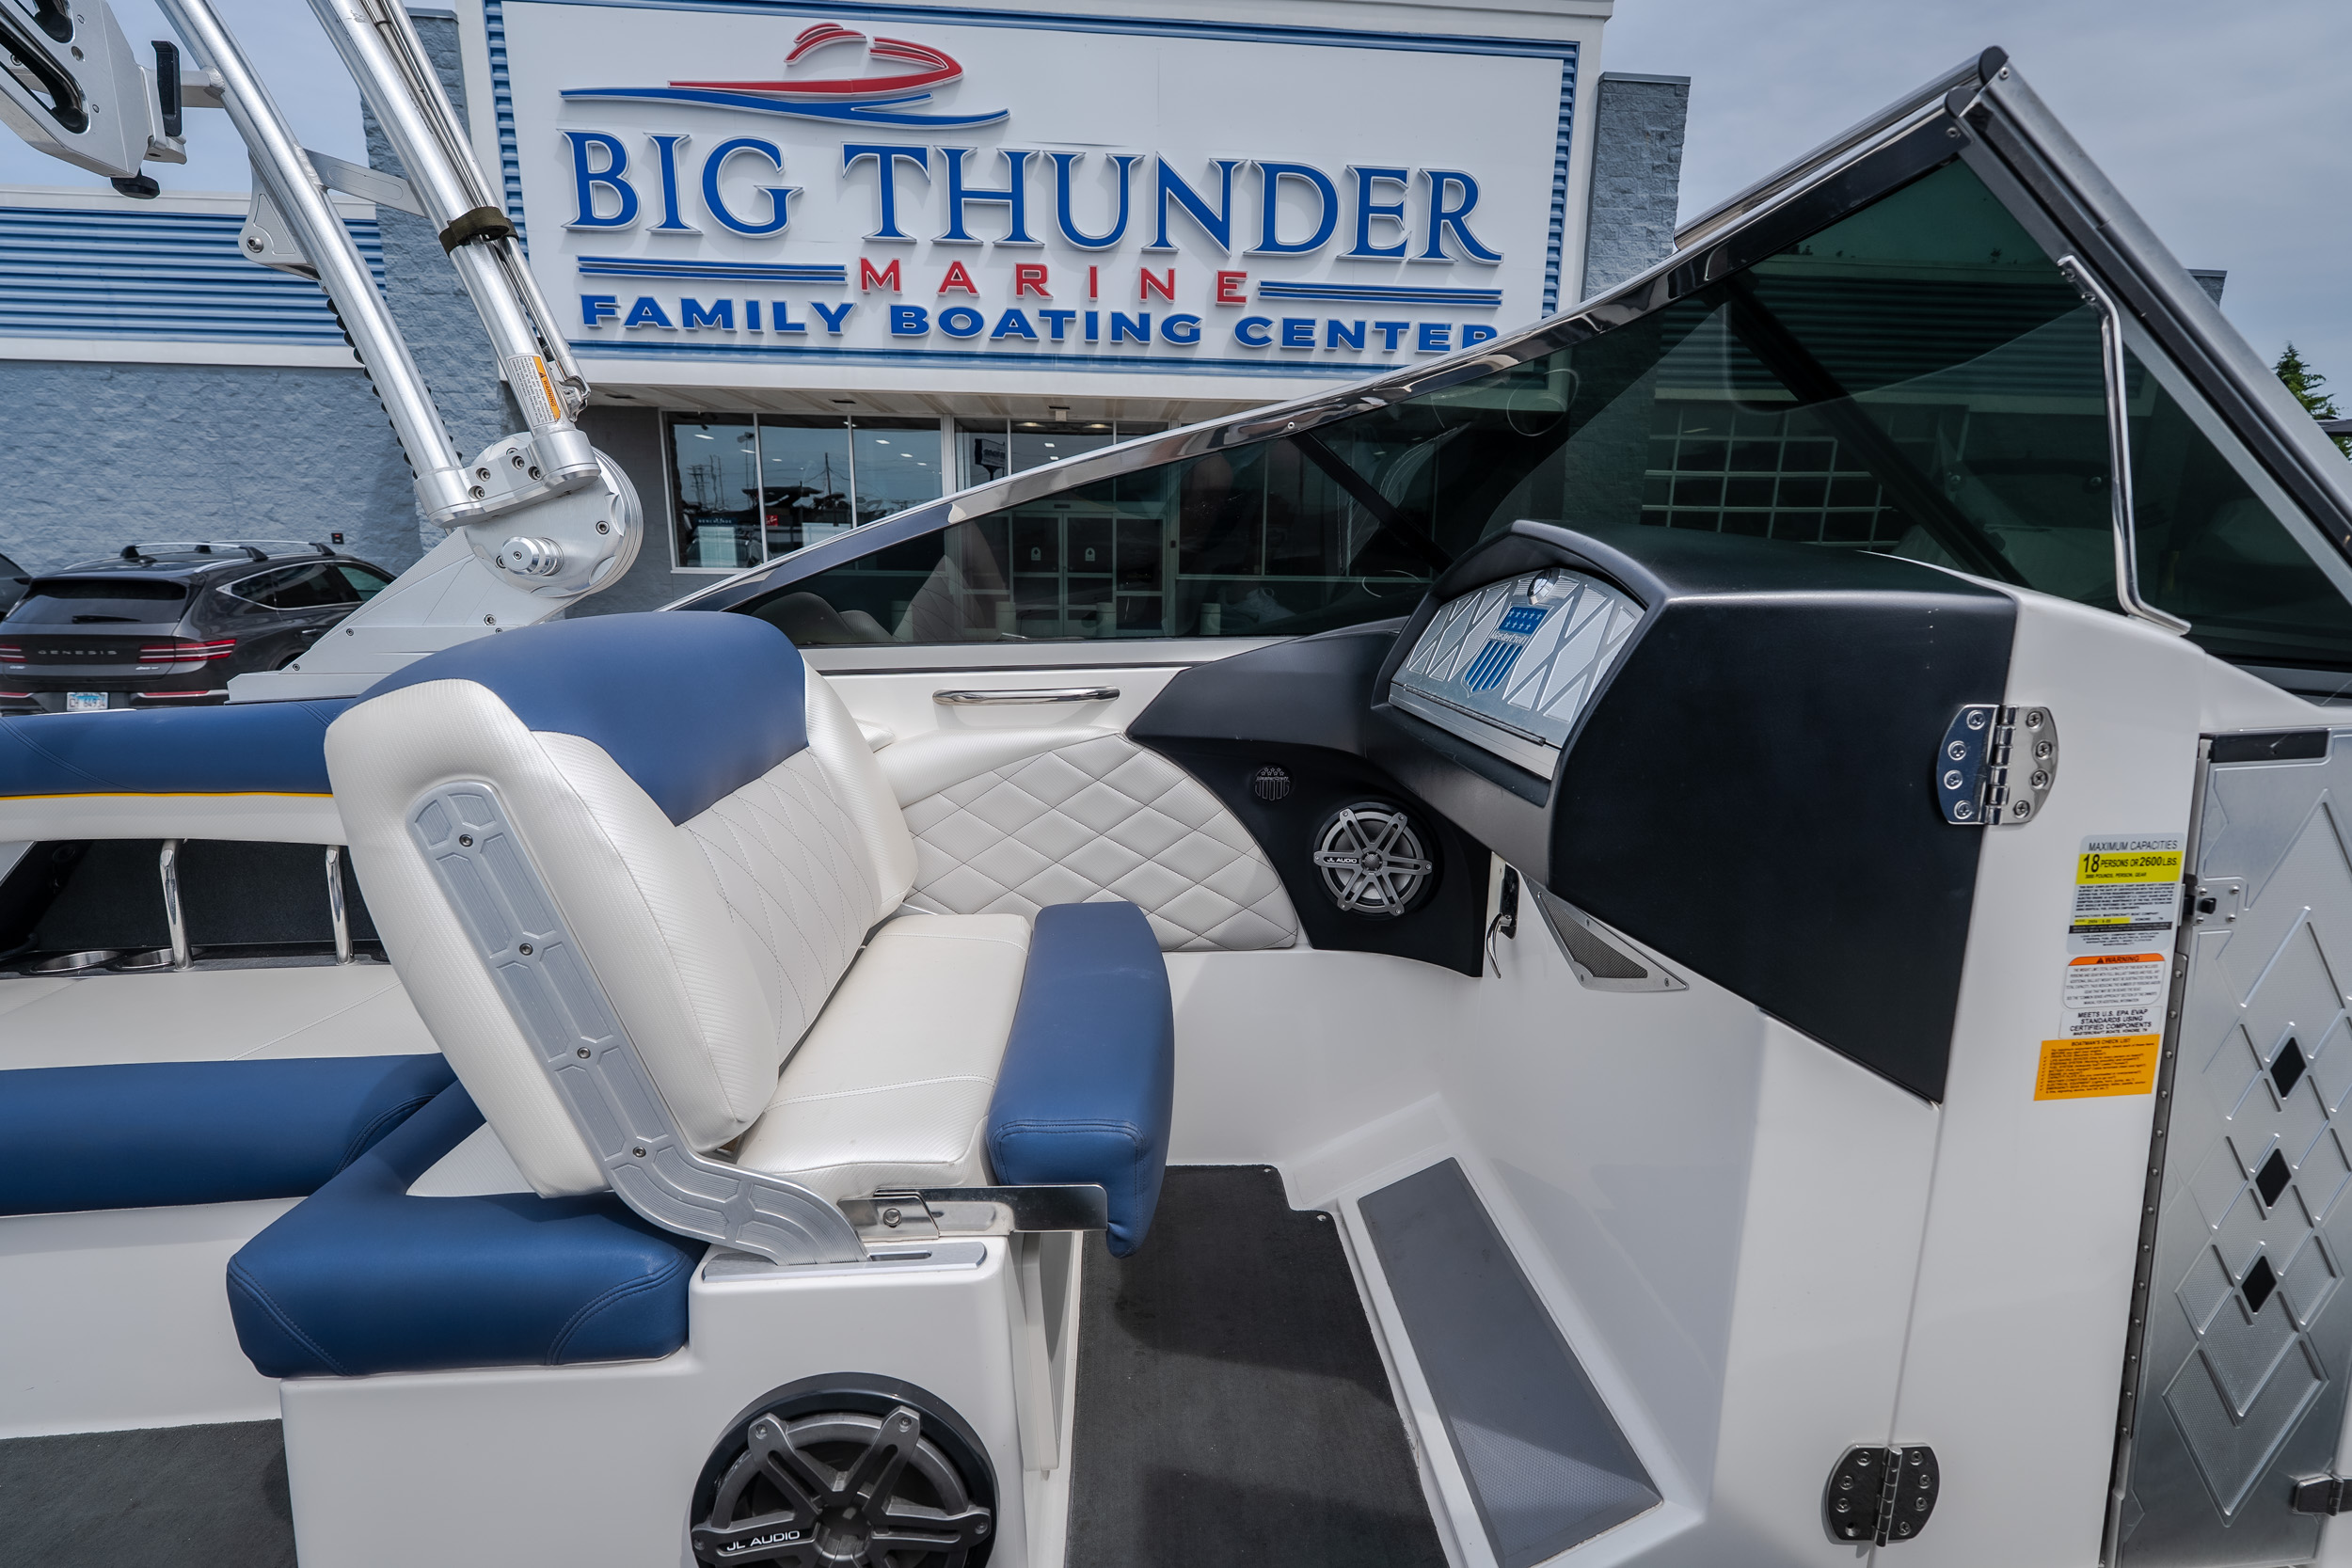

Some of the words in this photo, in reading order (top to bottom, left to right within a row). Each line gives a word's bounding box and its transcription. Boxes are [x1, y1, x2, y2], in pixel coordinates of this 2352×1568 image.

[557, 128, 803, 238] BIG
[841, 141, 1503, 266] THUNDER
[859, 256, 1248, 306] MARINE
[580, 293, 857, 336] FAMILY
[889, 303, 1202, 346] BOATING
[543, 379, 557, 407] WARNING
[2089, 841, 2128, 850] MAXIMUM
[2130, 840, 2177, 850] CAPACITIES
[2083, 854, 2100, 873] 18
[2100, 859, 2129, 867] PERSONS
[2139, 856, 2162, 866] 2600
[727, 1541, 745, 1551] JL
[750, 1530, 800, 1546] AUDIO
